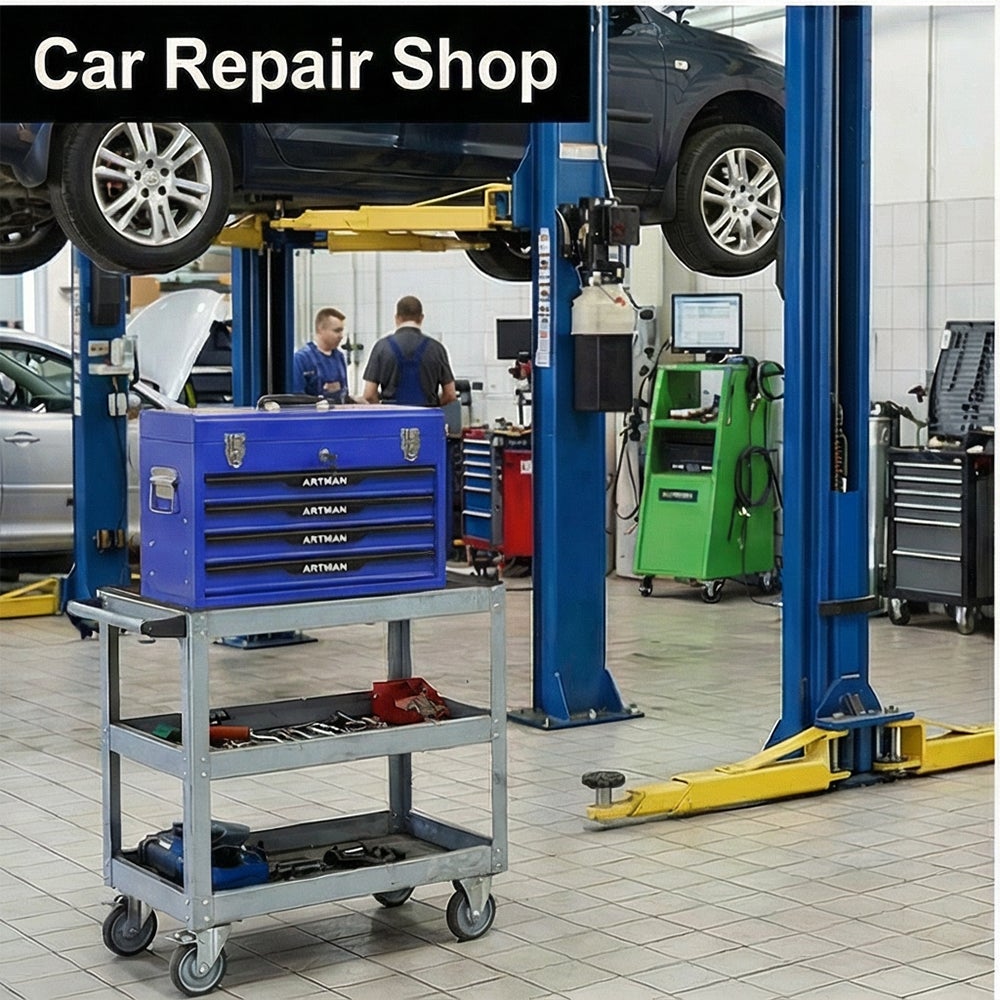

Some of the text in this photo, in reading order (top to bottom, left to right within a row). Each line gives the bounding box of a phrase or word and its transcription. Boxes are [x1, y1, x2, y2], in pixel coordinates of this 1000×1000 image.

[302, 476, 348, 487] ARTMAN
[302, 505, 348, 516] ARTMAN
[302, 534, 348, 545] ARTMAN
[302, 562, 348, 573] ARTMAN
